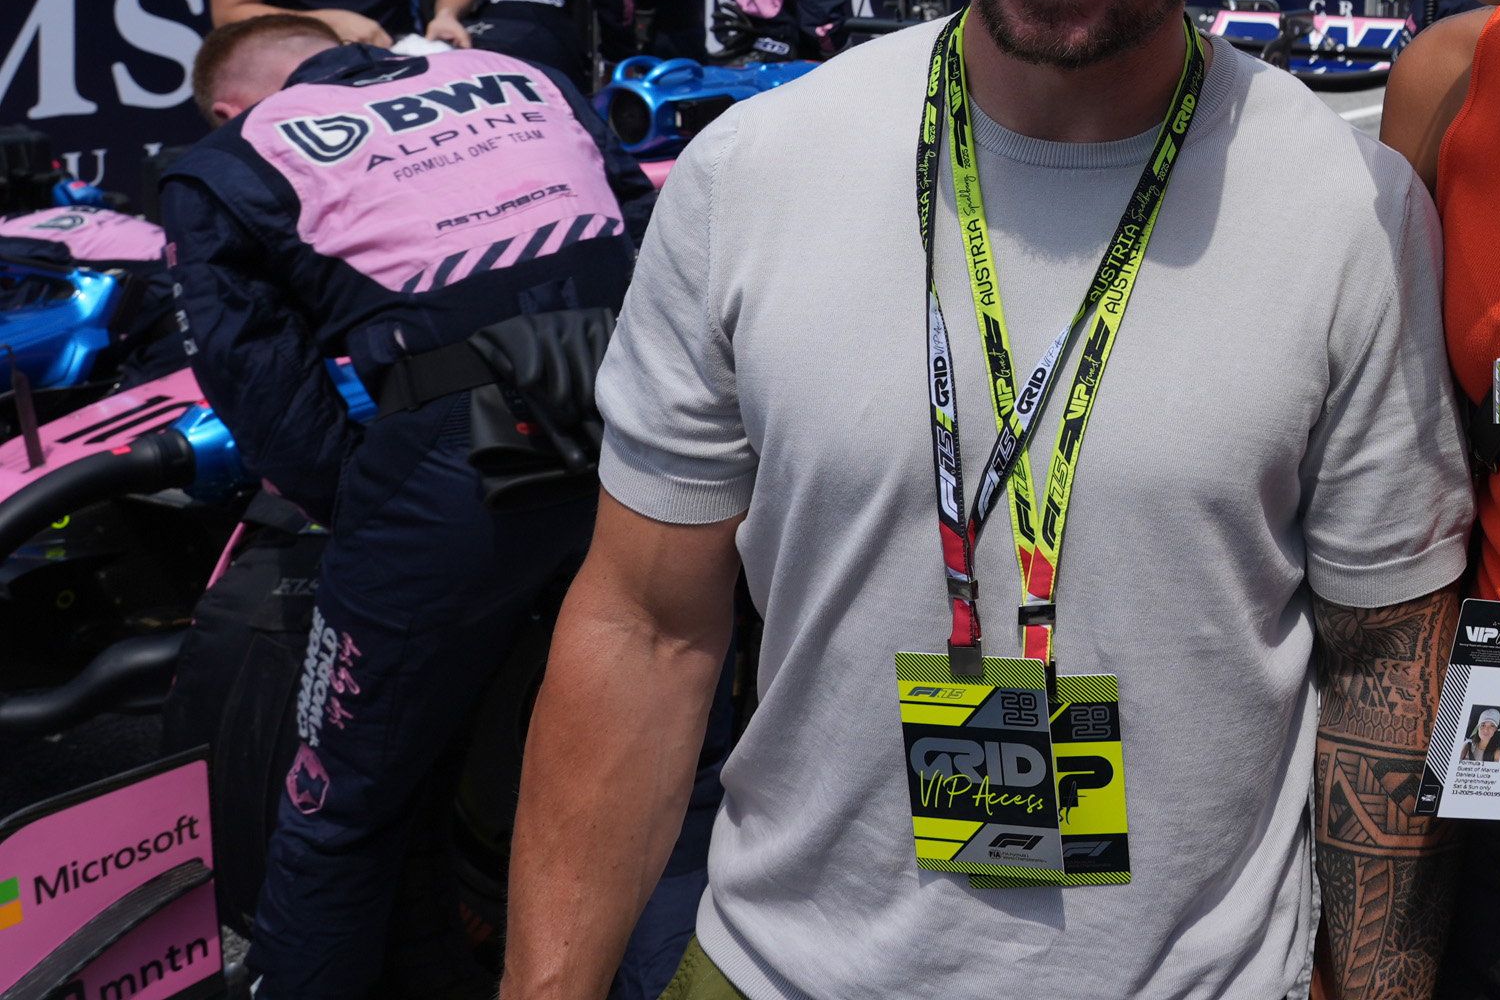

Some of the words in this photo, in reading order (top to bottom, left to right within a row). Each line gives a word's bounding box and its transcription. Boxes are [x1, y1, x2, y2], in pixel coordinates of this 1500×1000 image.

[927, 55, 941, 97] GRID
[368, 73, 546, 133] BWT
[365, 111, 547, 172] ALPINE
[393, 154, 465, 182] FORMULA
[511, 129, 546, 144] TEAM
[1090, 224, 1141, 303] AUSTRIA
[1172, 94, 1196, 135] GRID
[966, 218, 996, 306] AUSTRIA
[933, 356, 950, 408] GRID
[995, 378, 1014, 418] VIP
[1017, 366, 1047, 415] GRID
[1065, 383, 1089, 421] VIP
[1080, 353, 1100, 388] Guest
[1465, 625, 1499, 644] VIP
[909, 736, 1047, 788] GRID
[920, 769, 973, 809] VIP
[972, 775, 1044, 816] Access
[33, 814, 200, 905] Microsoft
[988, 832, 1045, 851] F1
[100, 936, 209, 1000] mntn
